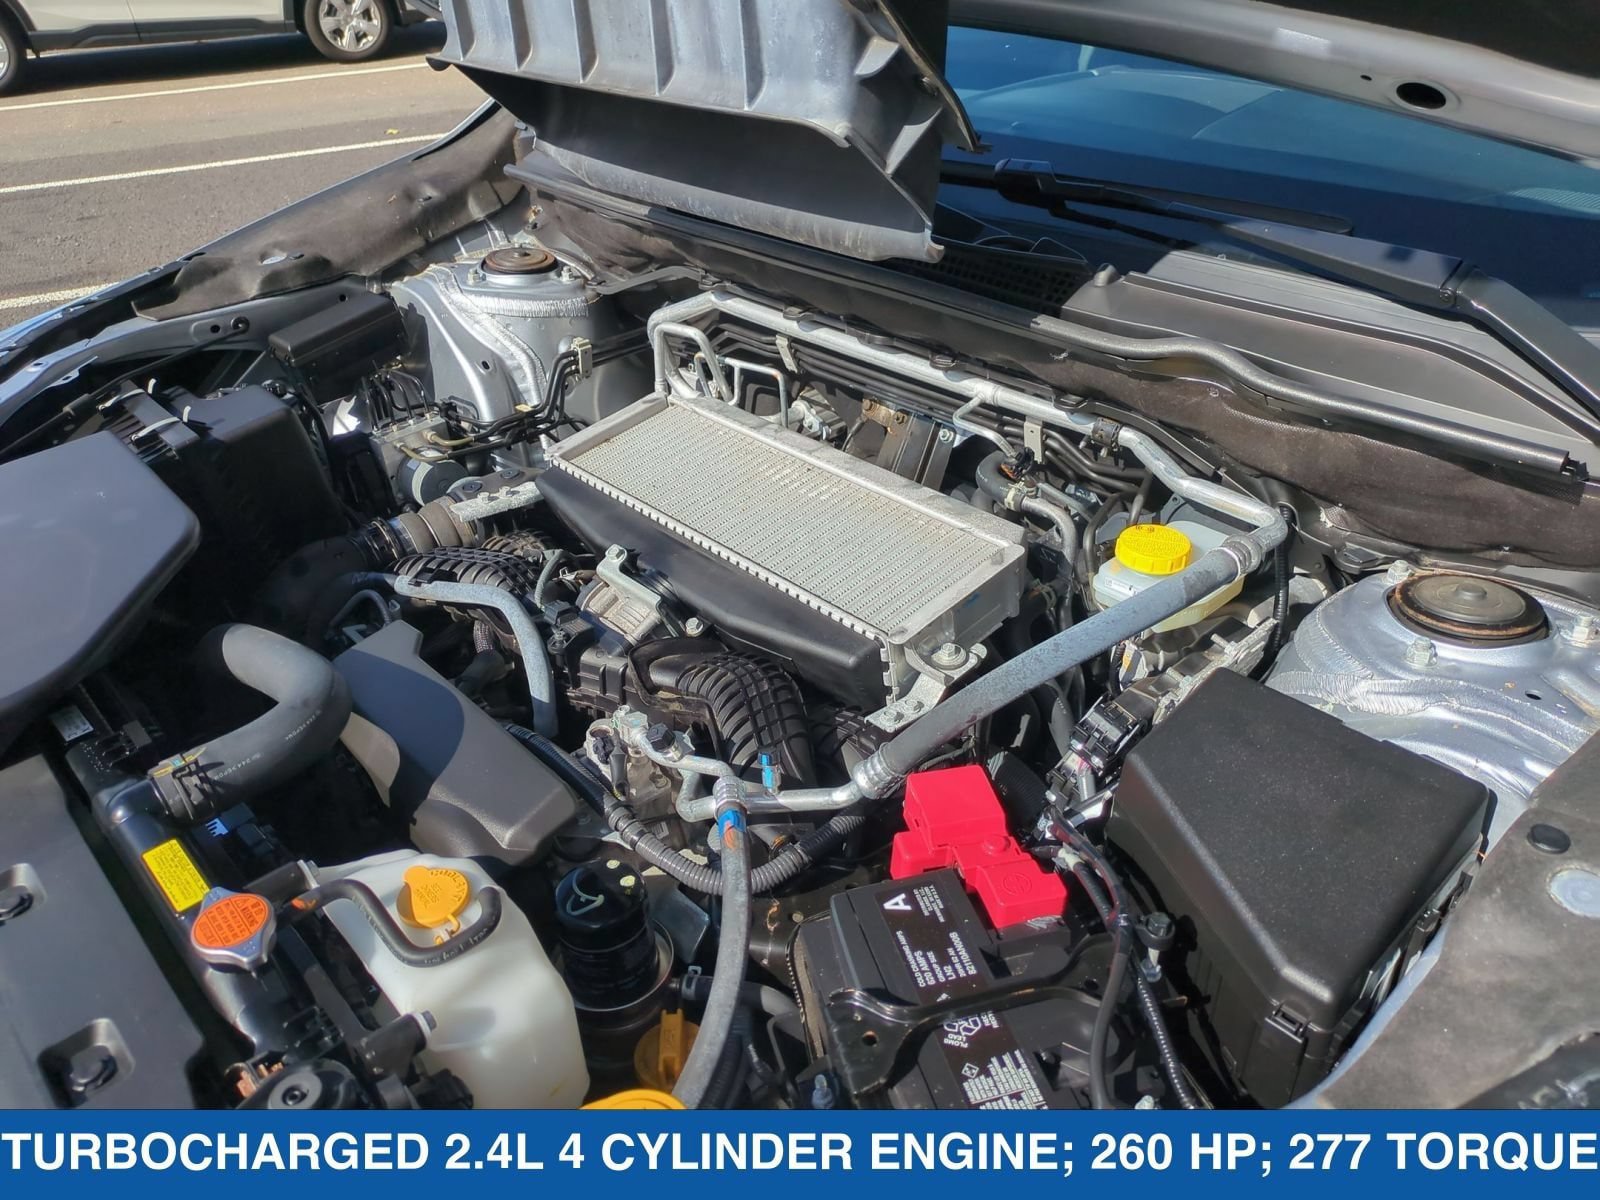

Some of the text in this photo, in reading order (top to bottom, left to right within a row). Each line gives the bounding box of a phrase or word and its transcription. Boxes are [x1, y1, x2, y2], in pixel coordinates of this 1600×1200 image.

[883, 893, 912, 910] A
[896, 931, 926, 987] COLD CRANKING AMPS
[914, 951, 930, 970] AMPS
[932, 963, 945, 982] GROUP
[944, 965, 956, 980] LN2
[944, 1038, 968, 1048] PLOMB
[948, 1033, 966, 1041] LEAD
